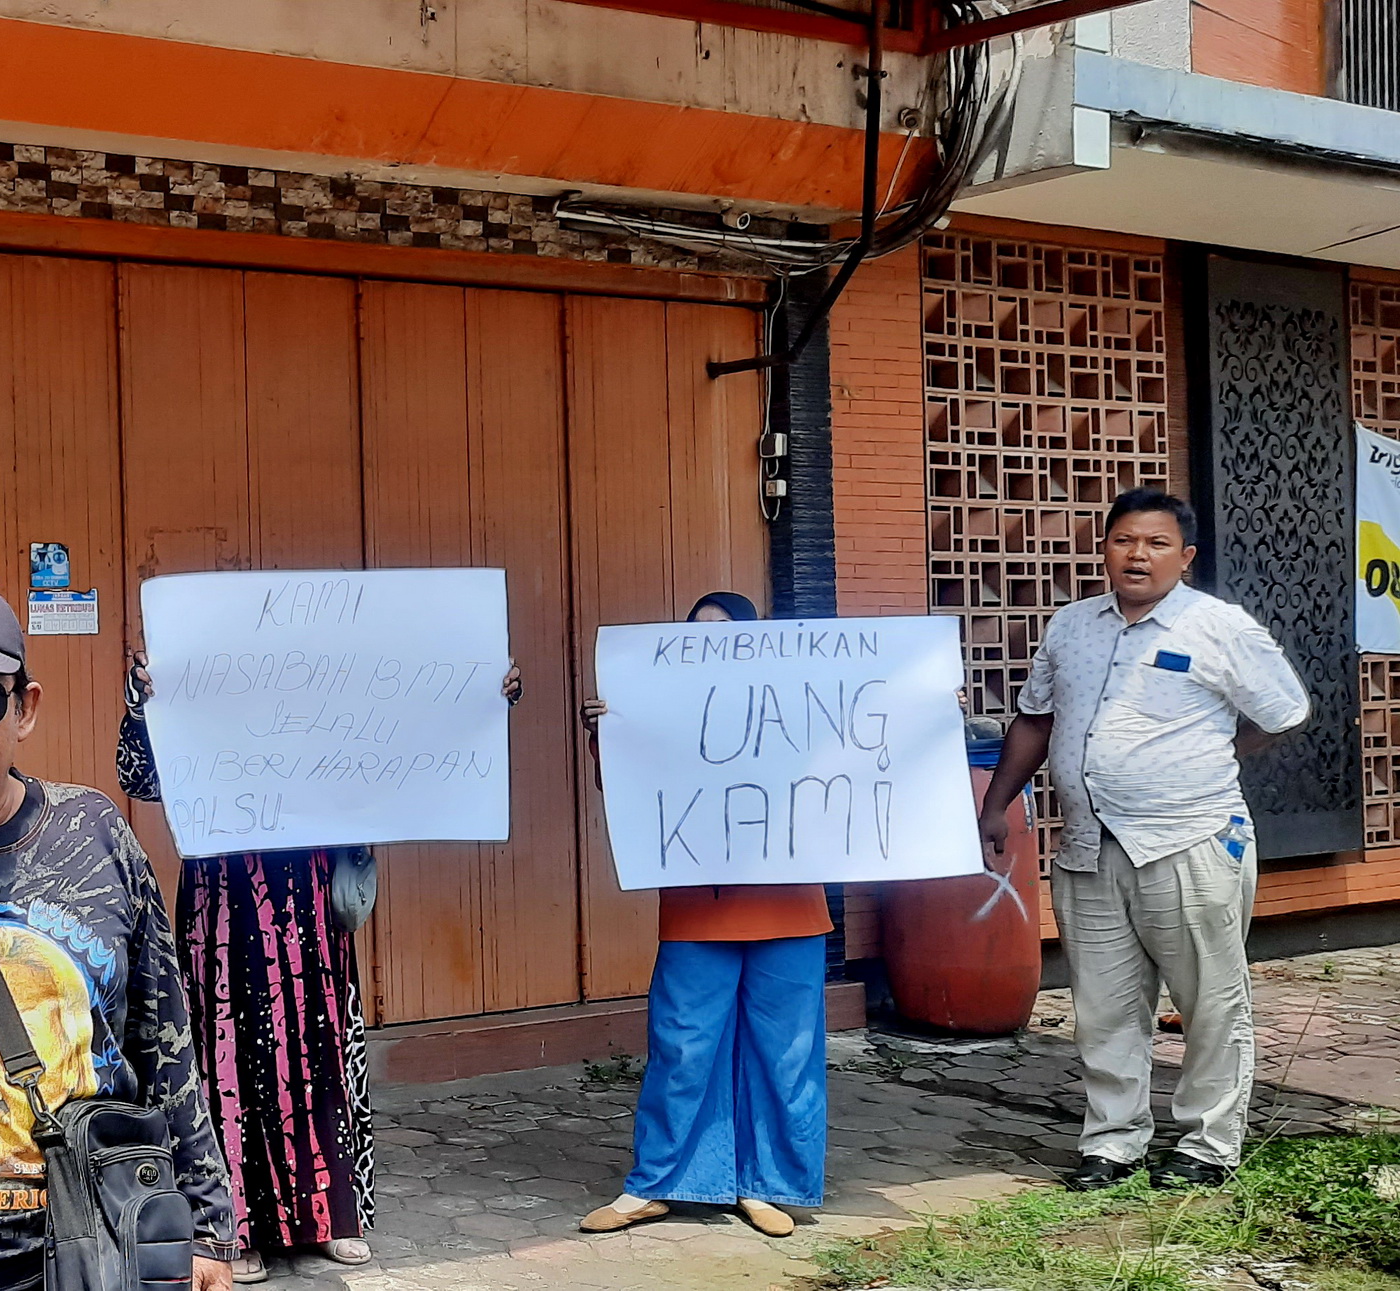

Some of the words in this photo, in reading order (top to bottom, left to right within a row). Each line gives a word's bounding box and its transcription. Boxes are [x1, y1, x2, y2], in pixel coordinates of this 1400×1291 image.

[255, 578, 365, 632] KAMI
[169, 650, 356, 706] NASABAH
[245, 700, 400, 745] SELALU
[700, 679, 889, 765] UANG
[306, 748, 493, 790] HARAPAN
